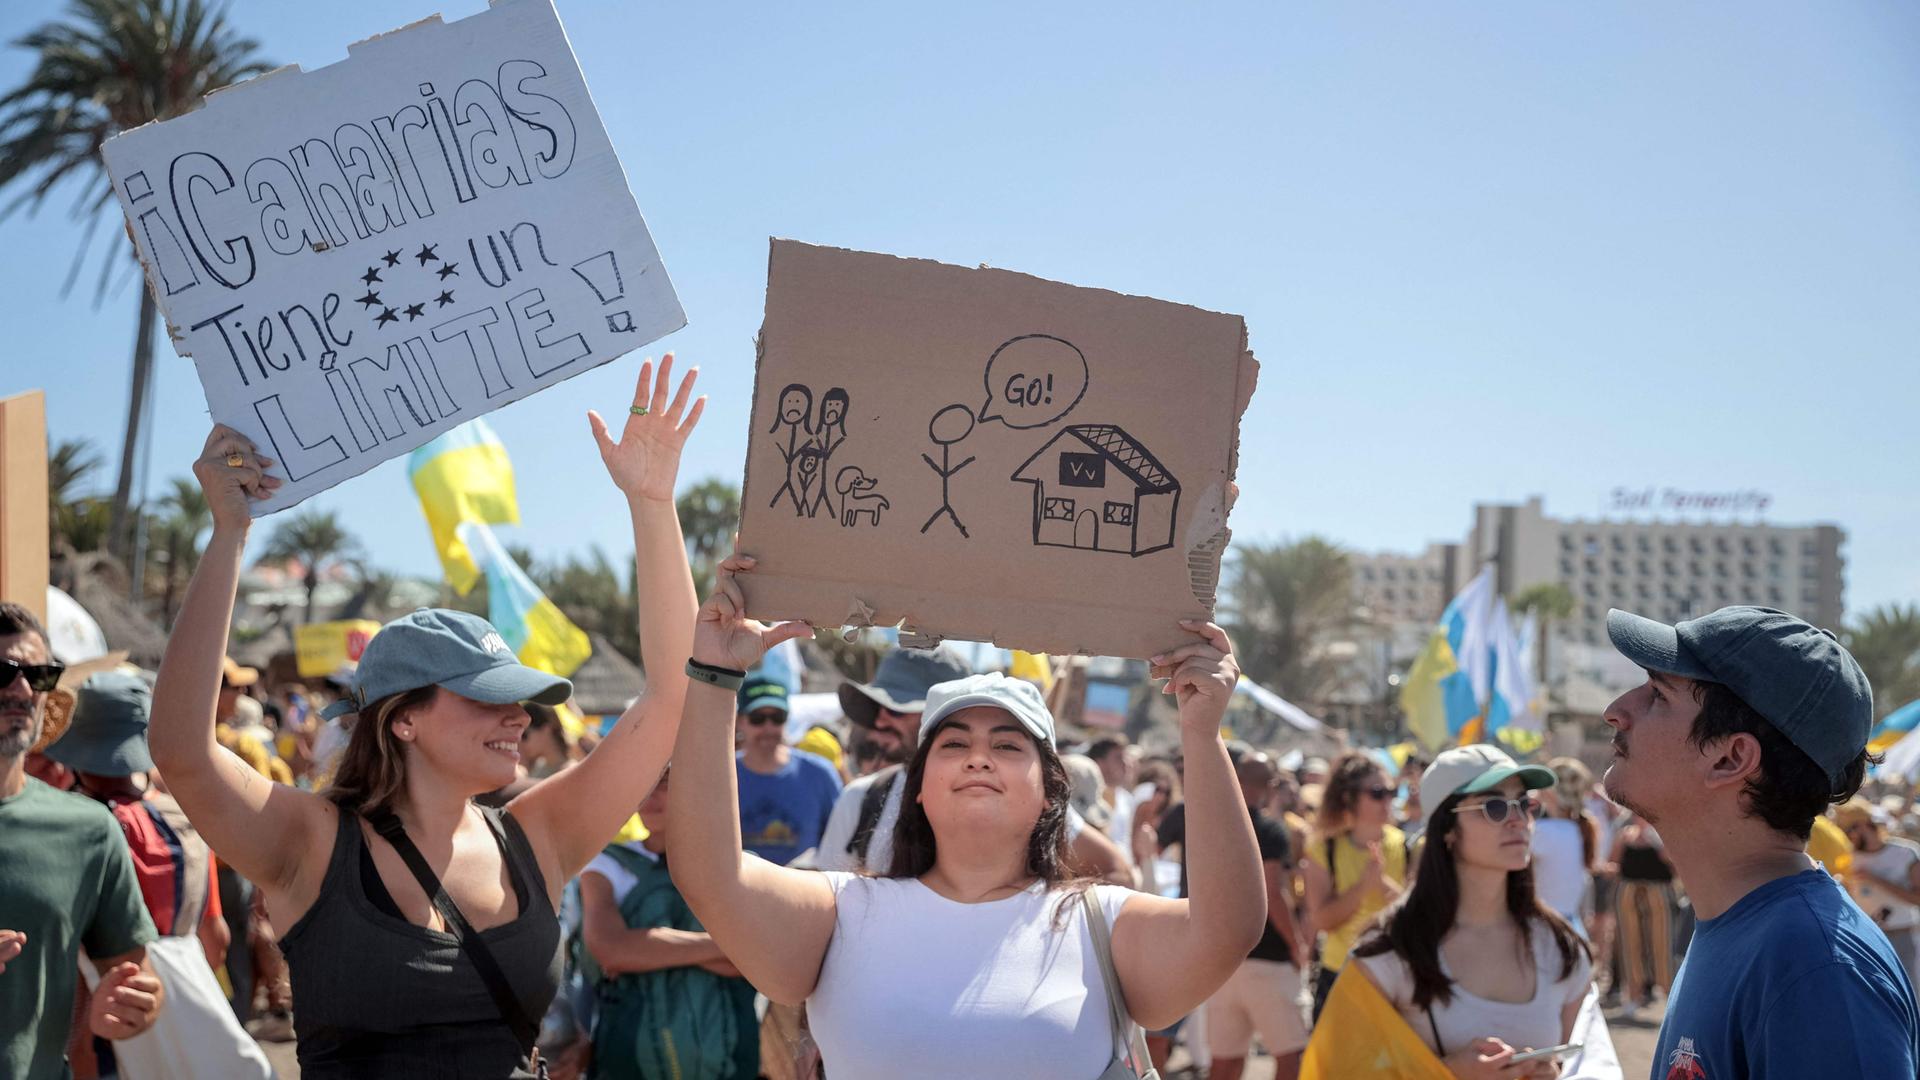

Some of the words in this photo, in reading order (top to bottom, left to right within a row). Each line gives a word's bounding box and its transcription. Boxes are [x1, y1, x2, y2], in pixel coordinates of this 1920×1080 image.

[191, 293, 353, 385] Tiene
[468, 222, 558, 287] un
[1004, 373, 1054, 408] GO!
